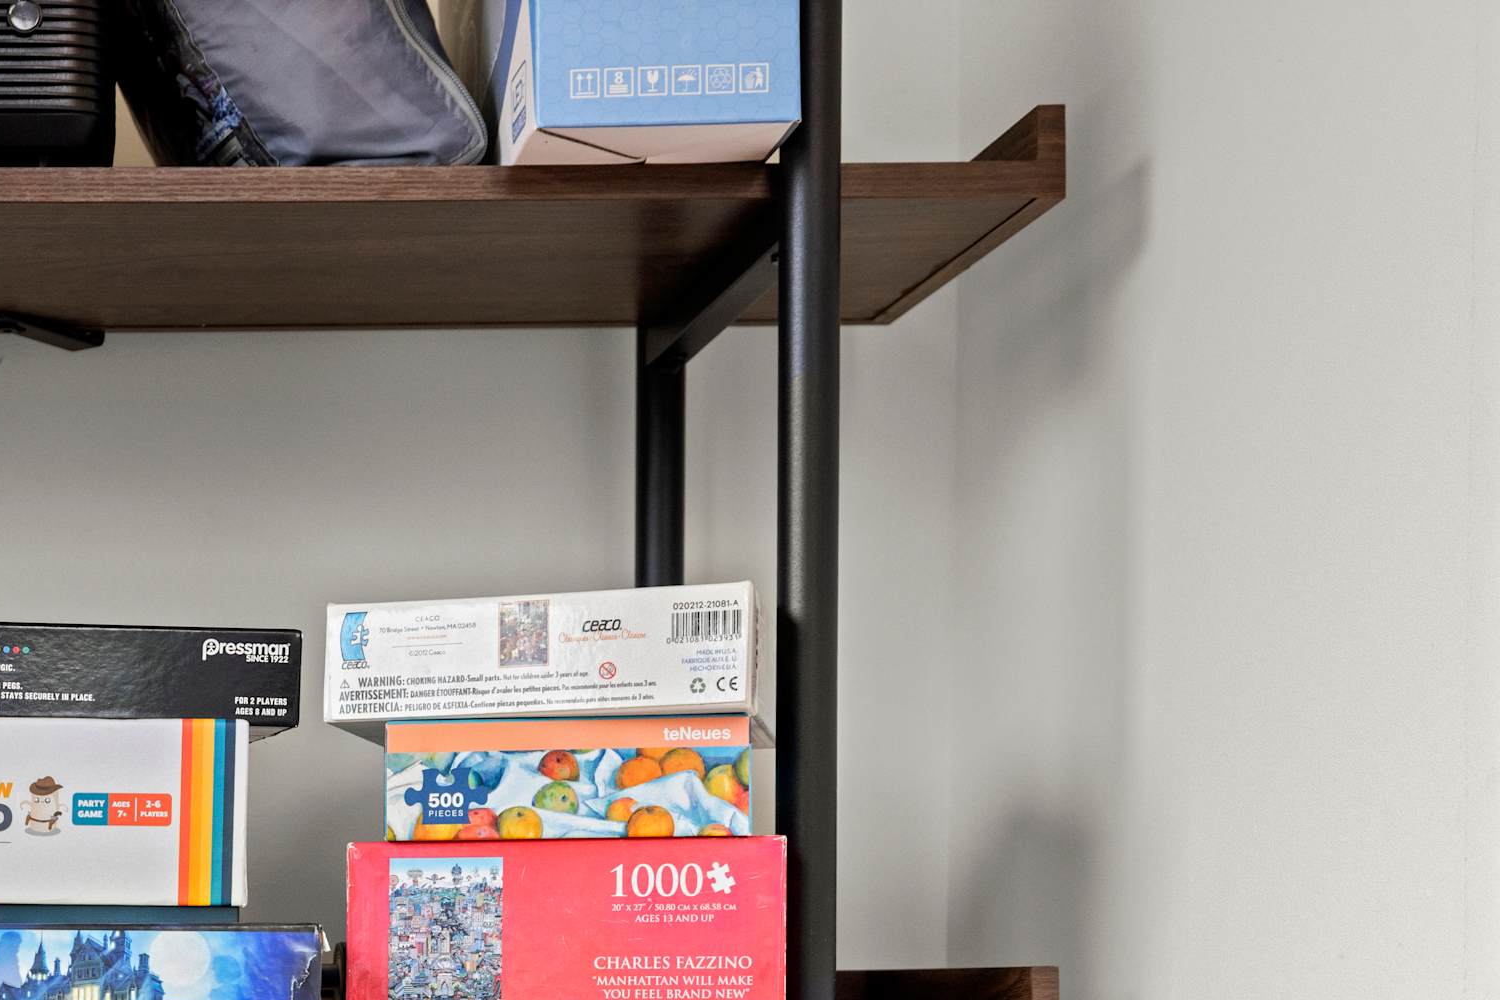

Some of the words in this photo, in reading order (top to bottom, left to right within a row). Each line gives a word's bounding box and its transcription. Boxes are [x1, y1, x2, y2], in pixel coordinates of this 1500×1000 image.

[246, 654, 268, 663] SINCE
[270, 655, 289, 663] 1922
[3, 682, 23, 690] PEGS.
[358, 676, 405, 688] WARNING:
[406, 676, 436, 686] CHOKING
[0, 691, 23, 700] STAYS
[25, 692, 60, 701] SECURELY
[62, 693, 69, 701] IN
[71, 693, 96, 702] PLACE.
[339, 688, 409, 701] AVERTISSEMENT:
[410, 689, 436, 698] DANGER
[234, 696, 248, 705] FOR
[250, 697, 255, 705] 2
[257, 697, 287, 706] PLAYERS
[255, 708, 260, 716] 8
[261, 708, 276, 716] AND
[339, 702, 402, 715] ADVERTENCIA:
[404, 704, 432, 712] PELIGRO
[433, 703, 441, 711] DE
[663, 726, 731, 741] teNeues
[78, 800, 105, 809] PARTY
[428, 792, 464, 808] 500
[78, 809, 103, 819] GAME
[117, 810, 127, 818] 7+
[428, 808, 464, 818] PIECES
[610, 863, 703, 898] 1000
[612, 903, 624, 912] 20"
[633, 903, 646, 912] 27"
[635, 915, 660, 923] AGES
[664, 914, 672, 923] 13
[675, 914, 699, 922] AND
[701, 914, 714, 922] UP
[593, 956, 670, 970] CHARLES
[676, 955, 753, 970] FAZZINO
[682, 976, 714, 986] WILL
[718, 976, 753, 986] MAKE
[603, 989, 631, 999] YOU
[635, 989, 663, 999] FEEL
[666, 989, 711, 999] BRAND
